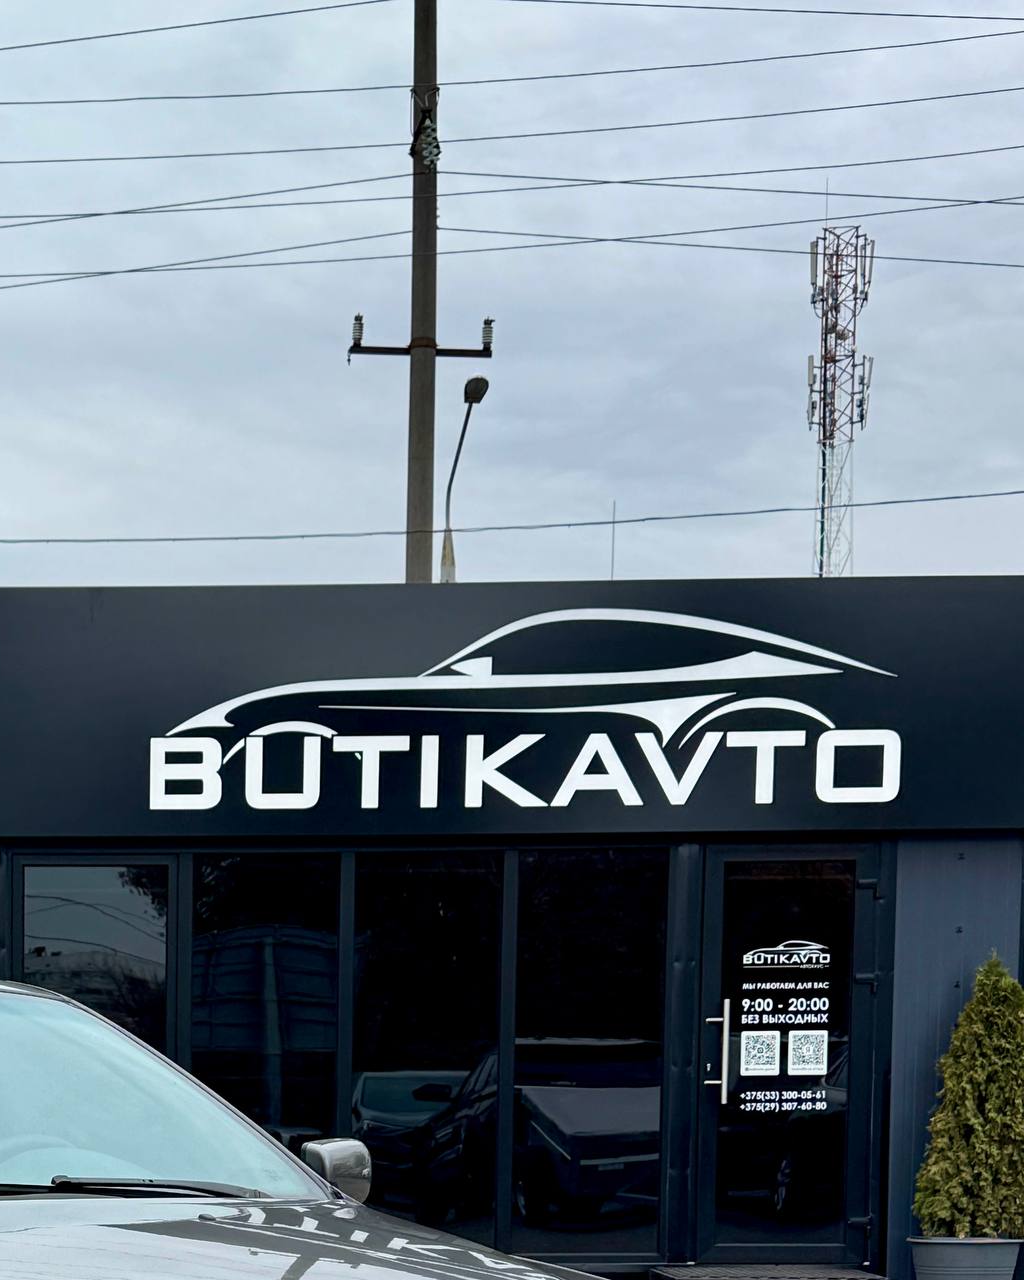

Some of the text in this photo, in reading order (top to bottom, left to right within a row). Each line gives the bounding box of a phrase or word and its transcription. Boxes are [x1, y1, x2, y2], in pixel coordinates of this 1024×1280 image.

[149, 729, 902, 810] BUTIKAVTO
[743, 953, 830, 965] BUTIKAVTO
[757, 982, 796, 990] РАБОТАЕМ
[796, 982, 812, 990] ДЛЯ
[742, 998, 773, 1012] 9:00
[788, 997, 829, 1011] 20:00
[741, 1013, 828, 1025] БЕЗ ВЫХОДНЫХ
[740, 1090, 826, 1102] +375(33) 300-05-61
[740, 1102, 827, 1113] +375(29) 307-60-80
